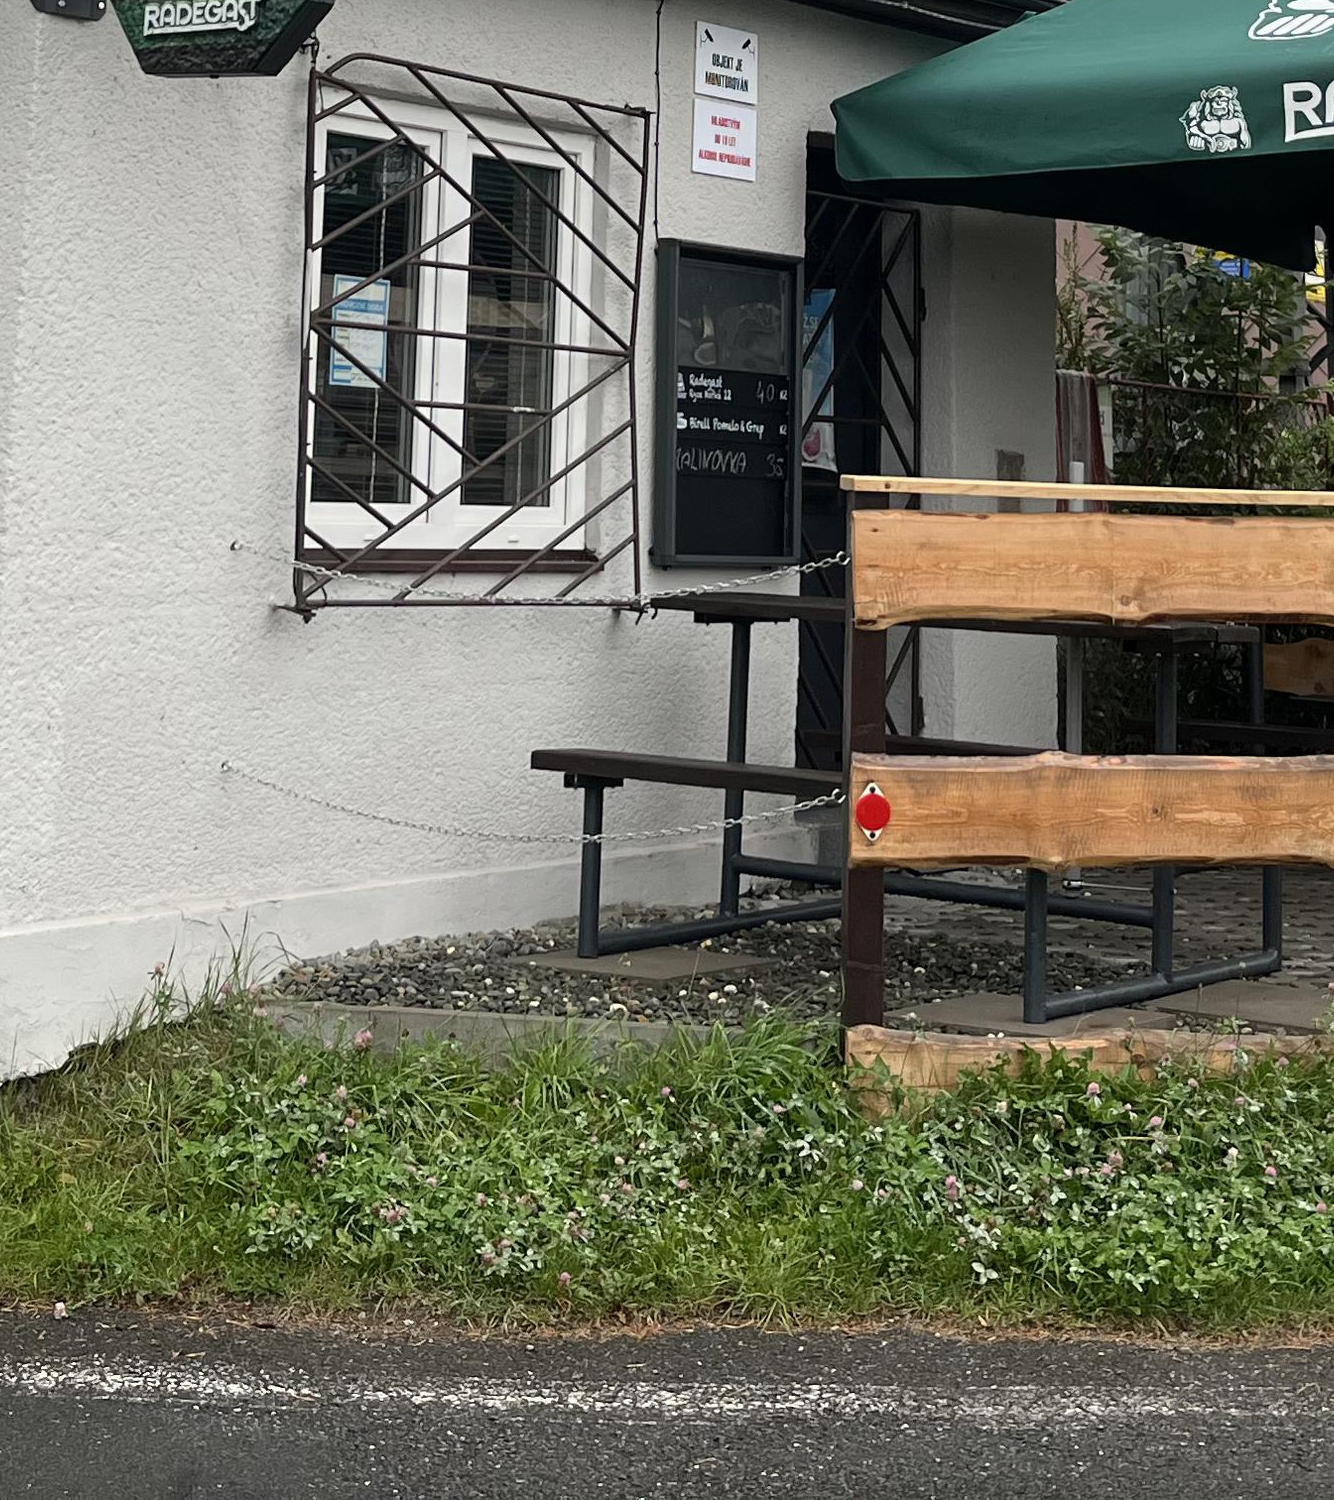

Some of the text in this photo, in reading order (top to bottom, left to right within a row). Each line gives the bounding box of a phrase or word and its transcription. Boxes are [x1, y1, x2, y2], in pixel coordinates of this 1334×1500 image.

[712, 53, 743, 72] OBJEKT JE
[755, 380, 775, 404] 40
